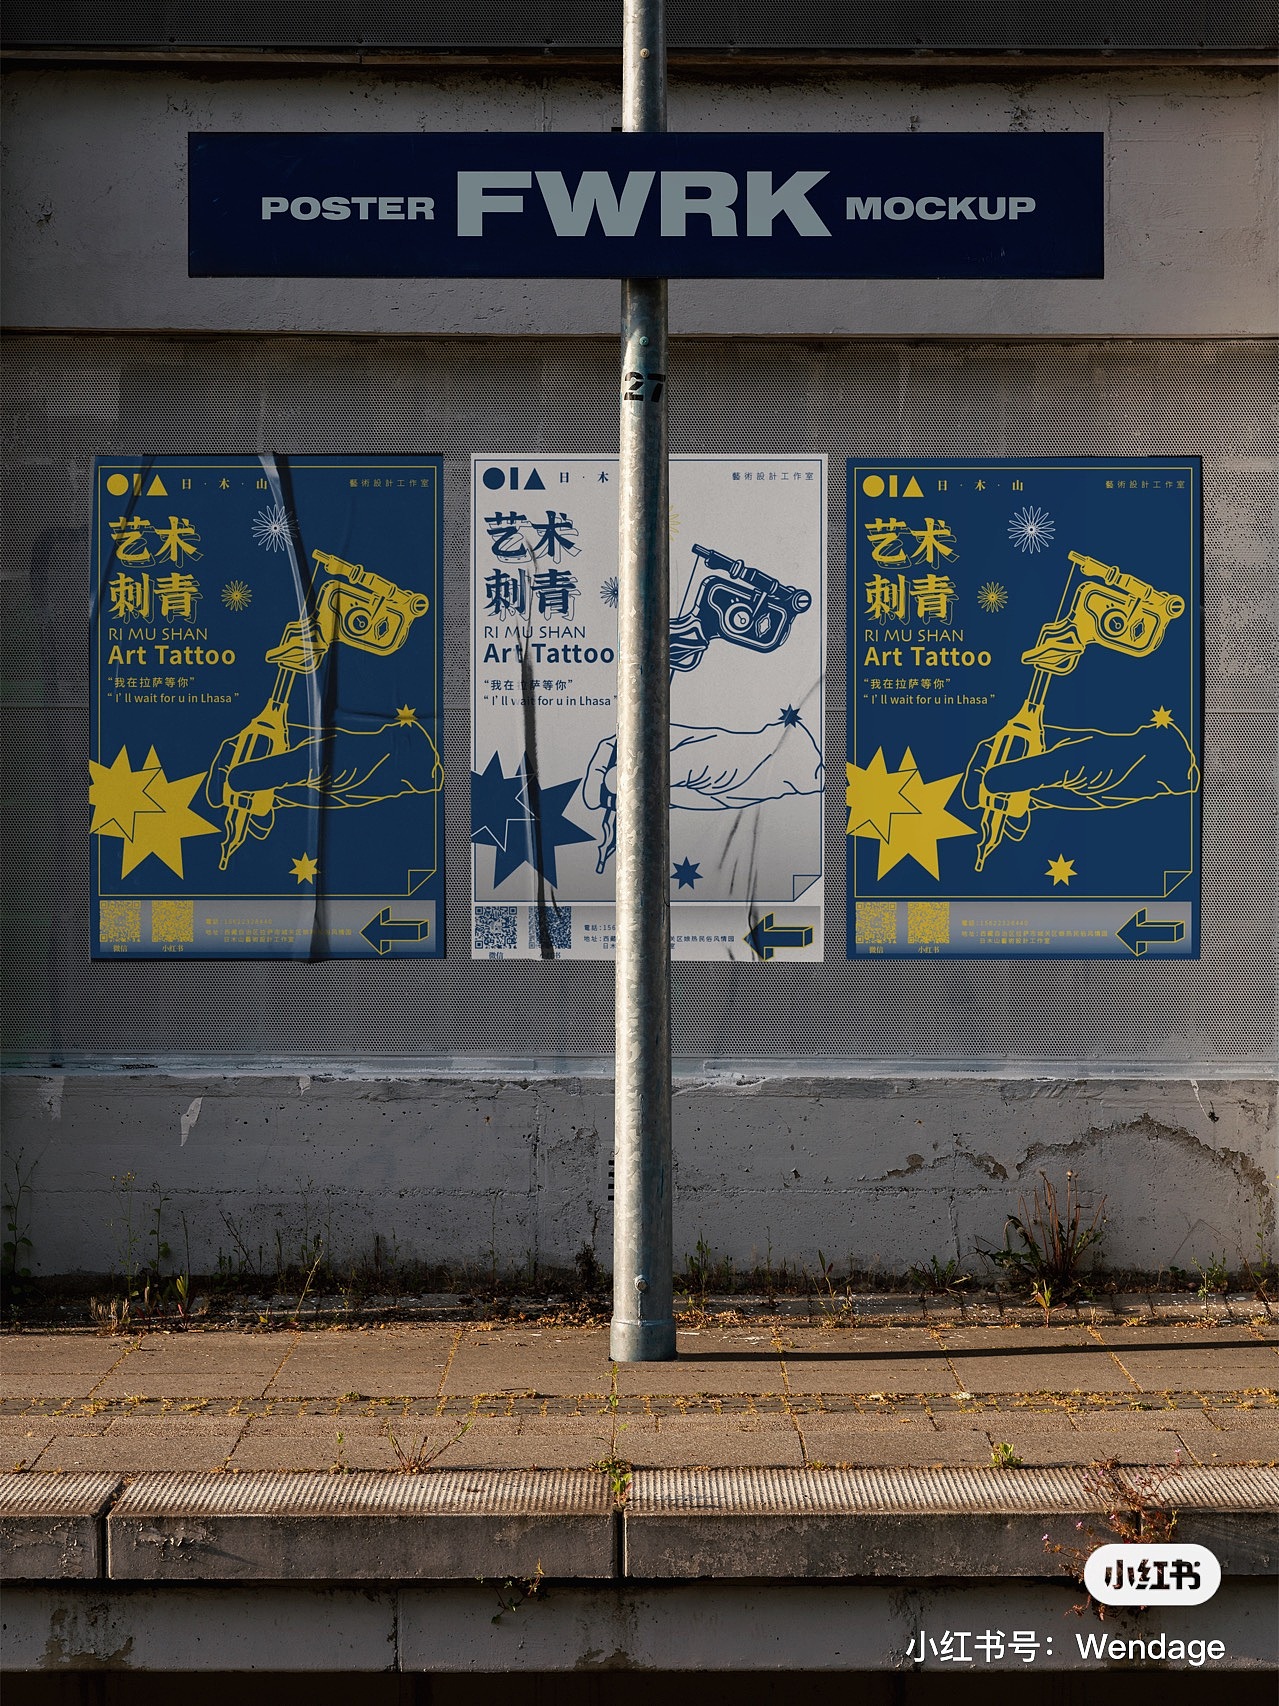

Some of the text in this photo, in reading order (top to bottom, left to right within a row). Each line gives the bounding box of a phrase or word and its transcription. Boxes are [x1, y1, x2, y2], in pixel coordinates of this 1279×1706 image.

[262, 171, 1035, 236] POSTER FWRK MOCKUP
[624, 372, 666, 403] 27
[732, 472, 813, 480] 藝術設計工作室
[109, 516, 197, 562] 艺术
[484, 511, 575, 557] 艺术
[865, 518, 952, 562] 艺术
[108, 572, 198, 618] 刺青
[483, 568, 576, 615] 刺青
[865, 573, 953, 618] 刺青
[108, 627, 207, 641] RI MU SHAN
[485, 624, 585, 640] RI MU SHAN
[864, 629, 964, 642] RI MU SHAN
[108, 645, 236, 665] Art Tattoo
[484, 643, 614, 666] Art Tattoo
[864, 646, 992, 666] Art Tattoo
[133, 694, 157, 703] wait
[160, 693, 176, 703] for
[178, 695, 185, 704] u
[188, 694, 198, 703] in
[538, 696, 553, 705] for
[567, 696, 576, 705] in
[890, 695, 913, 704] wait
[915, 694, 931, 704] for
[934, 697, 941, 705] u
[943, 694, 954, 704] in
